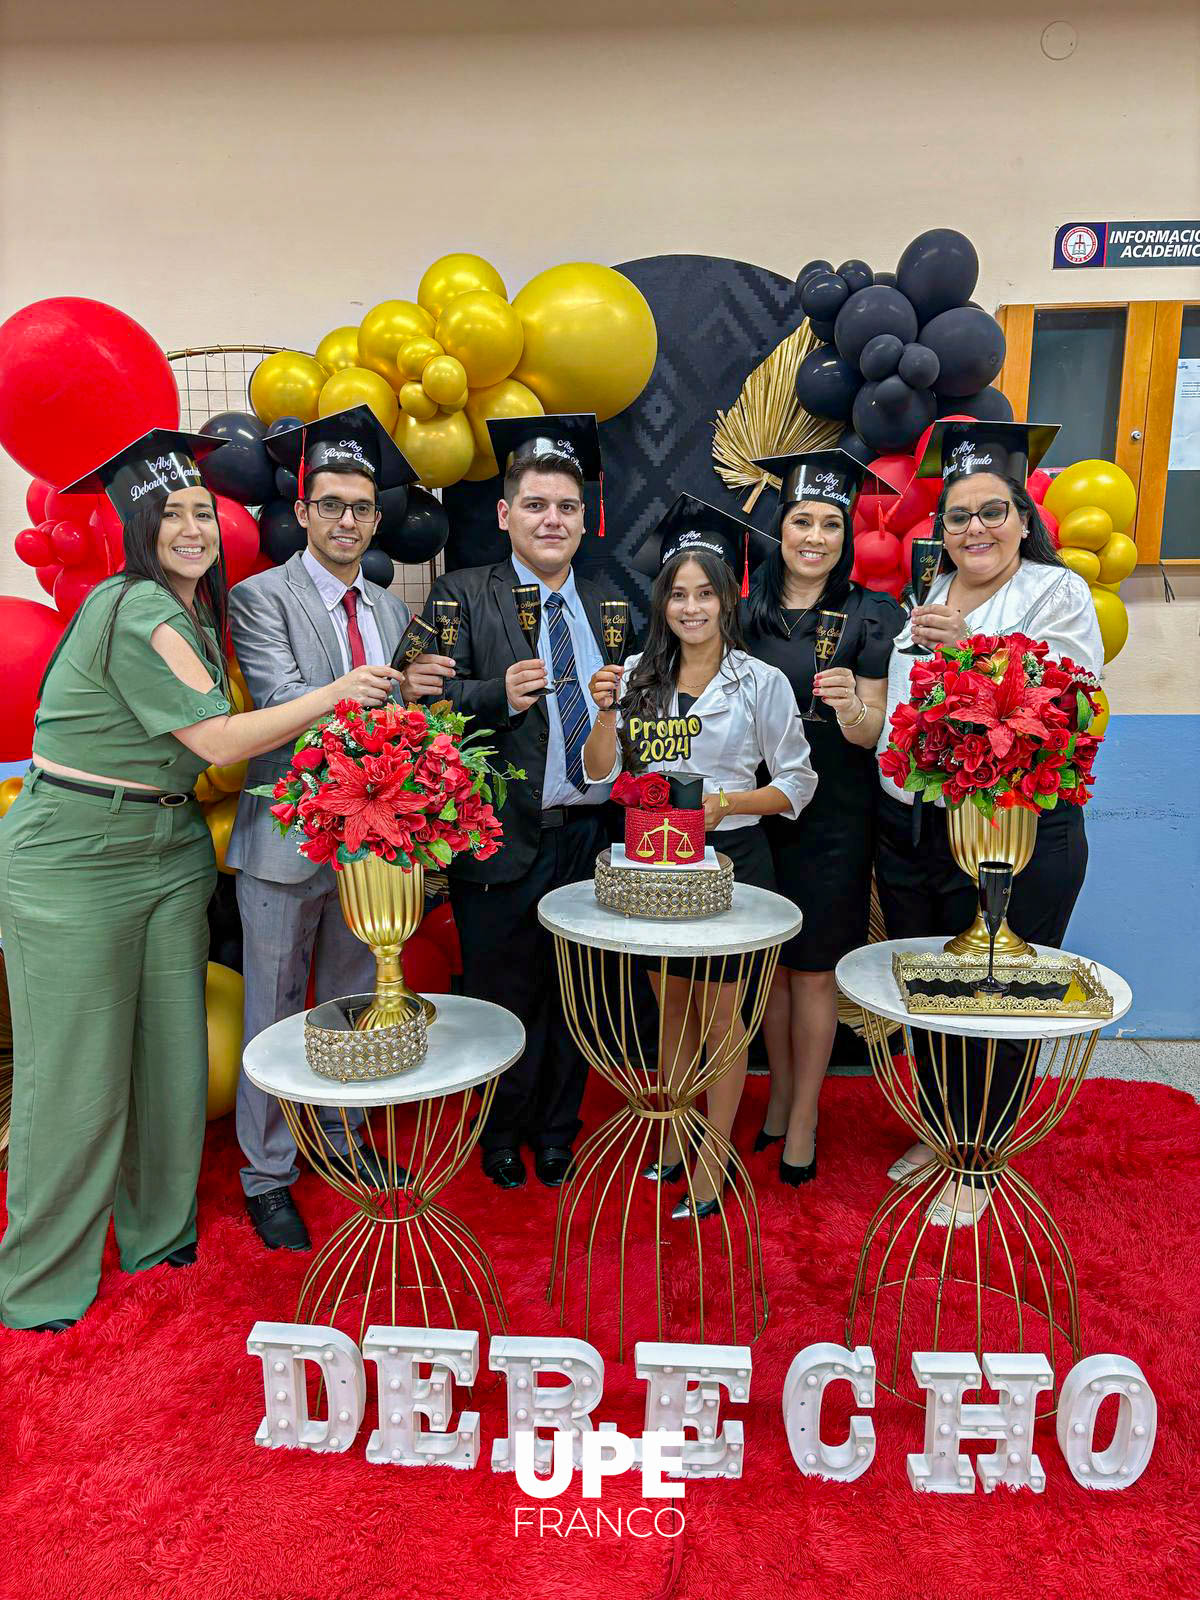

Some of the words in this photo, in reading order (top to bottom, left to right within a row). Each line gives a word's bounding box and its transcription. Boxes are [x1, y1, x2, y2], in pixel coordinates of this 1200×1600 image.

[321, 447, 353, 460] Roque
[339, 440, 363, 453] Abg.
[557, 439, 575, 454] Abg.
[952, 440, 976, 458] Abg.
[130, 472, 168, 502] Deborah
[815, 472, 840, 487] Abg.
[629, 717, 700, 741] Promo
[639, 735, 689, 762] 2024
[246, 1321, 1157, 1494] DERECHO
